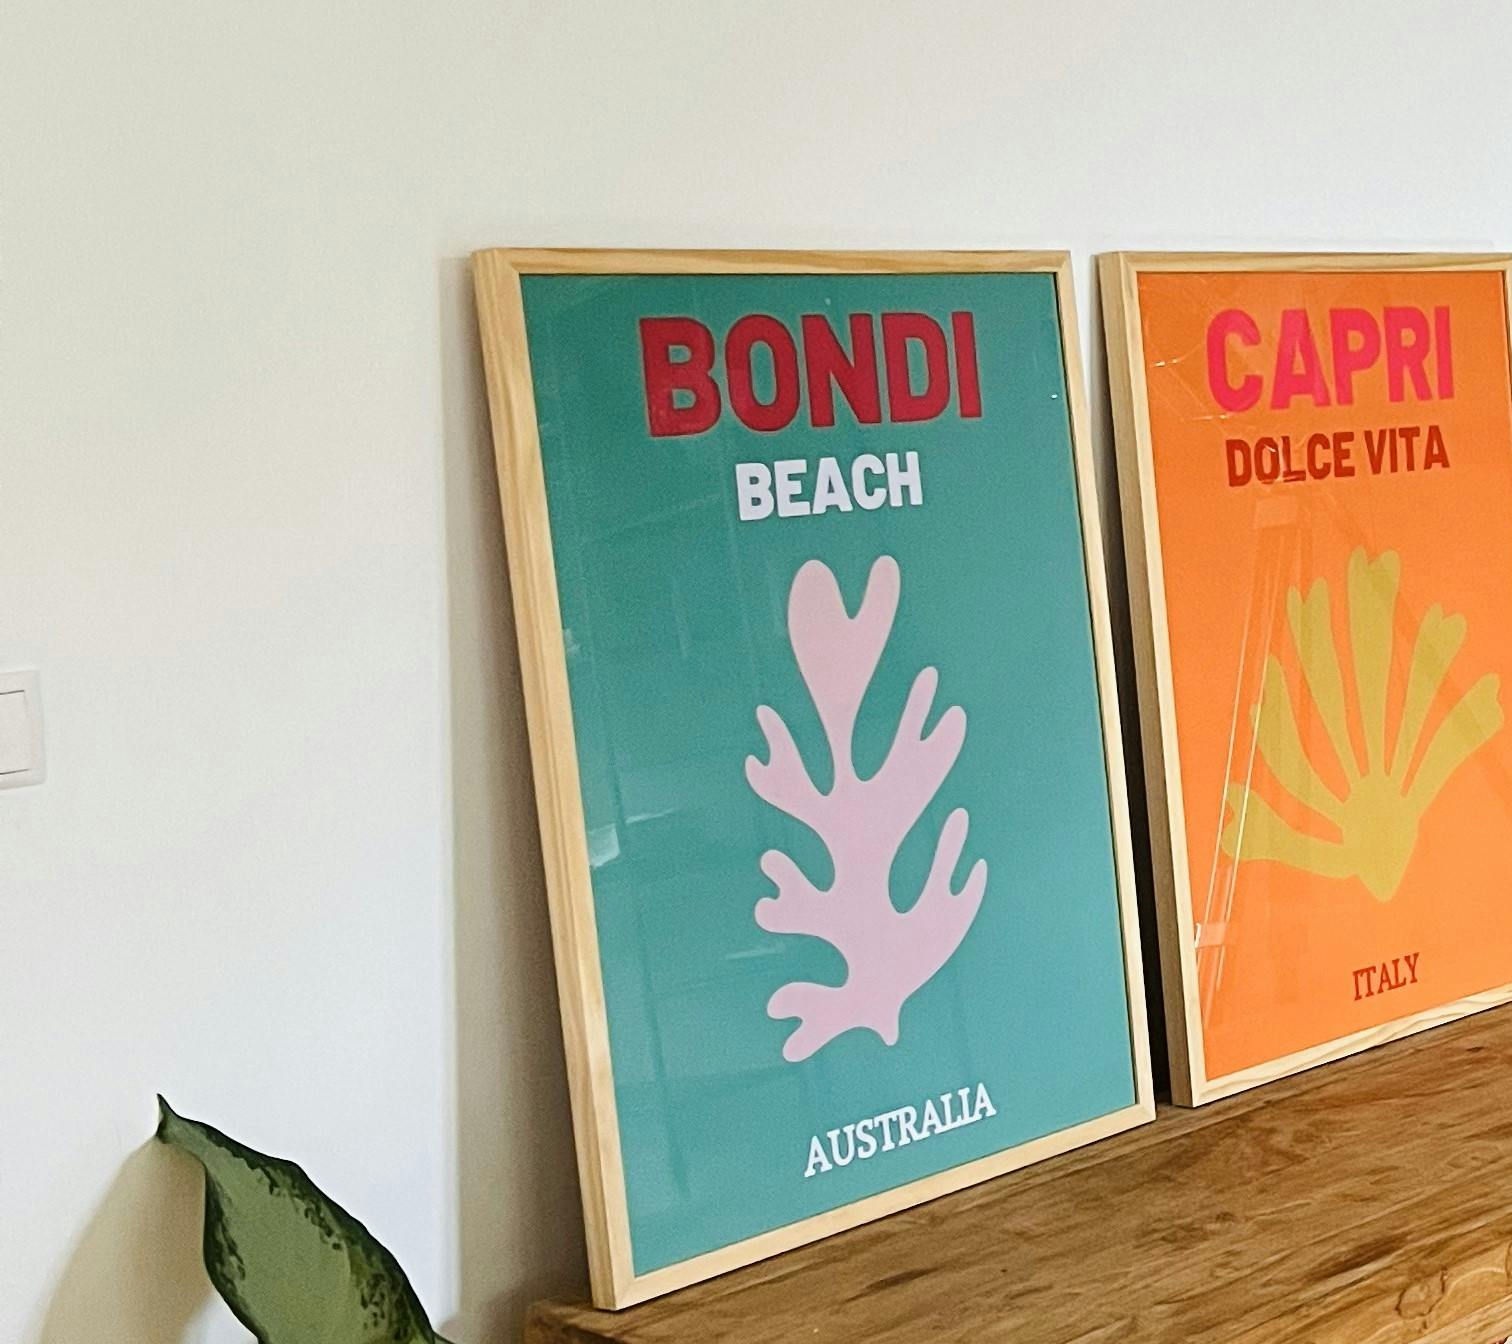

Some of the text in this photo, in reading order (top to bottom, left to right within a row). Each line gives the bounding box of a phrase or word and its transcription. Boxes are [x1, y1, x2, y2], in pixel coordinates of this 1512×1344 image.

[639, 311, 983, 439] BONDI
[1206, 306, 1457, 414] CAPRI
[735, 451, 923, 522] BEACH
[1225, 425, 1450, 488] DOLCE VITA
[1352, 952, 1420, 1002] ITALY
[804, 1083, 997, 1179] AUSTRALIA
